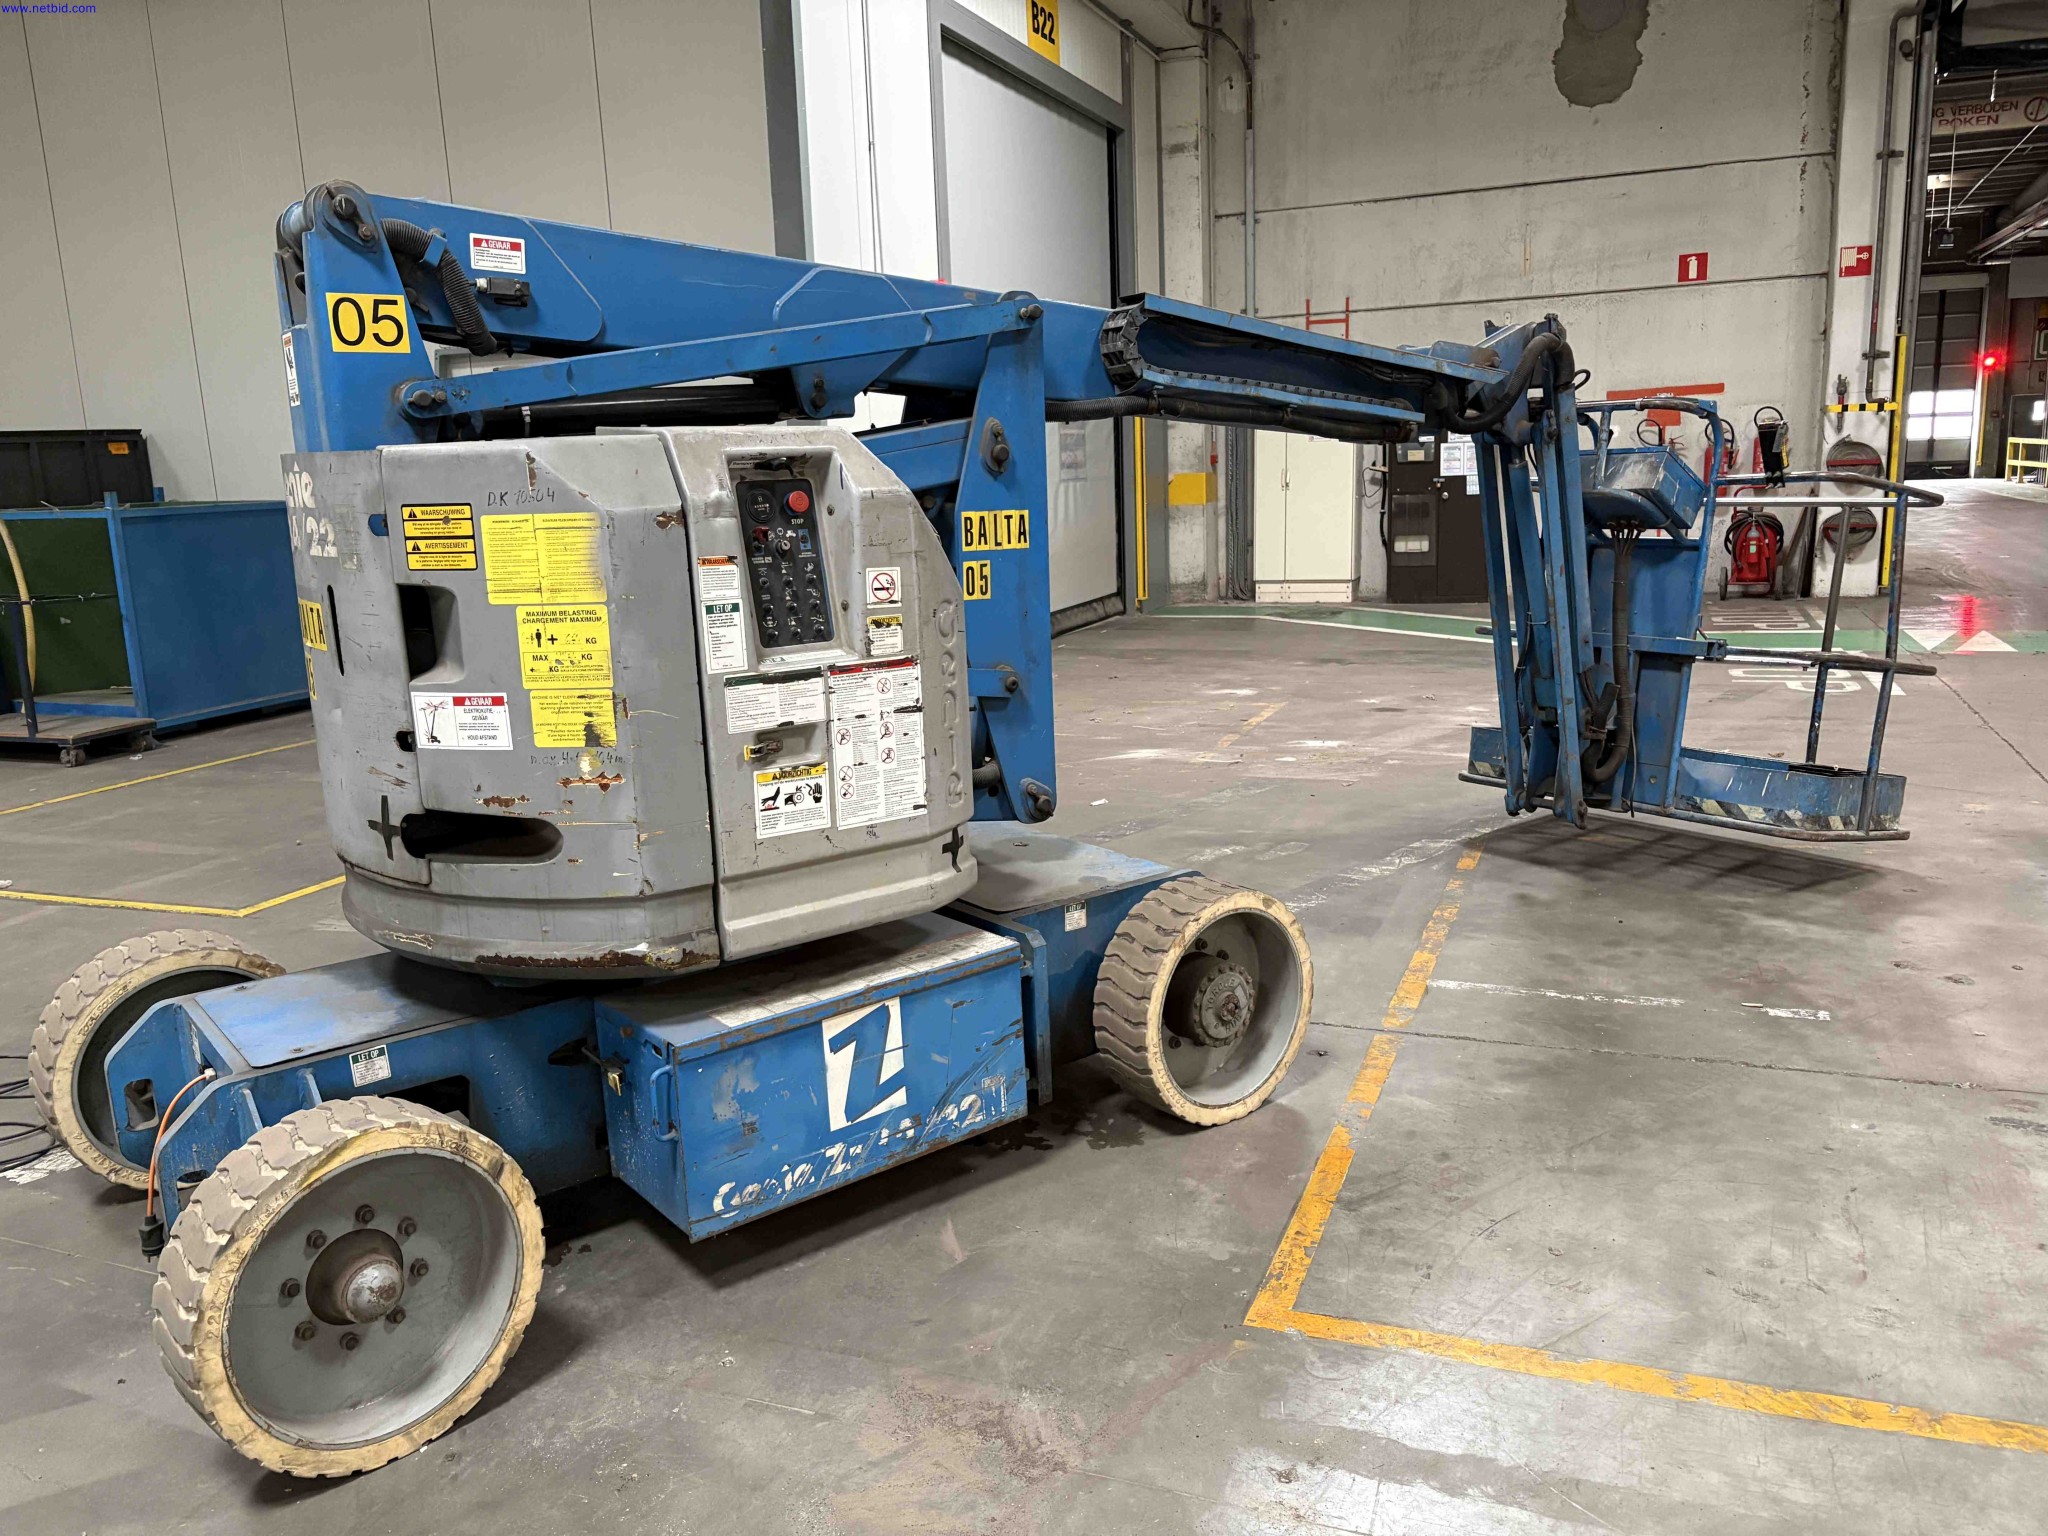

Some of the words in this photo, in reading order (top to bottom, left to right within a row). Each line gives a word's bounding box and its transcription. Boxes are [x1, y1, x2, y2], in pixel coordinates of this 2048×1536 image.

[1032, 0, 1055, 45] B22
[1951, 101, 2018, 116] VERBODEN
[488, 240, 511, 250] GEVAAR
[332, 297, 404, 347] 05
[420, 508, 466, 516] WAARSCHUWING
[963, 513, 1028, 548] BALTA
[424, 542, 468, 550] AVERTISSEMENT
[966, 563, 989, 597] 05
[713, 605, 724, 613] LET
[724, 604, 733, 612] OP
[581, 653, 593, 661] KG
[471, 698, 492, 706] GEVAAR
[935, 600, 963, 808] Genie
[358, 1052, 370, 1062] LET
[370, 1050, 379, 1058] OP
